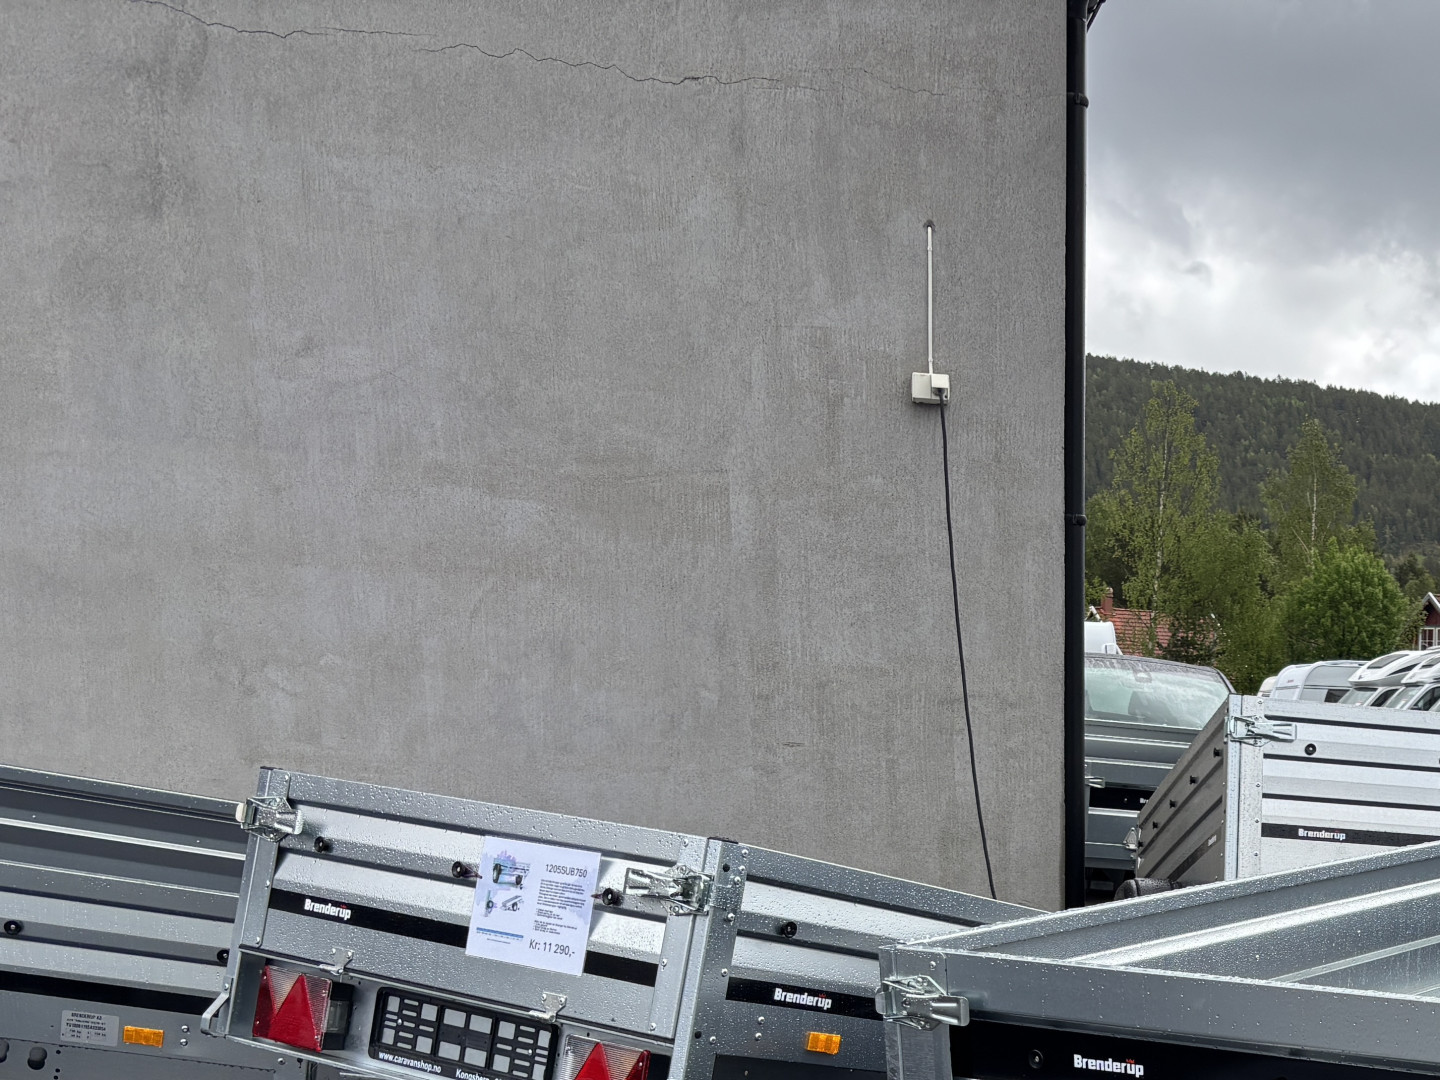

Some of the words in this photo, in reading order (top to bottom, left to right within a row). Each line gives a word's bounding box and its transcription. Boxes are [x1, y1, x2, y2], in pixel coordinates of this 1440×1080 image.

[1298, 828, 1346, 841] Brenderup
[545, 864, 588, 878] 1205SUB750
[304, 898, 352, 921] Brenderup
[529, 939, 541, 951] Kr:
[543, 942, 552, 953] 11
[553, 943, 576, 958] 290,-
[774, 987, 832, 1010] Brenderup
[378, 1051, 442, 1074] www.caravanshop.no
[1073, 1053, 1144, 1078] Brenderup
